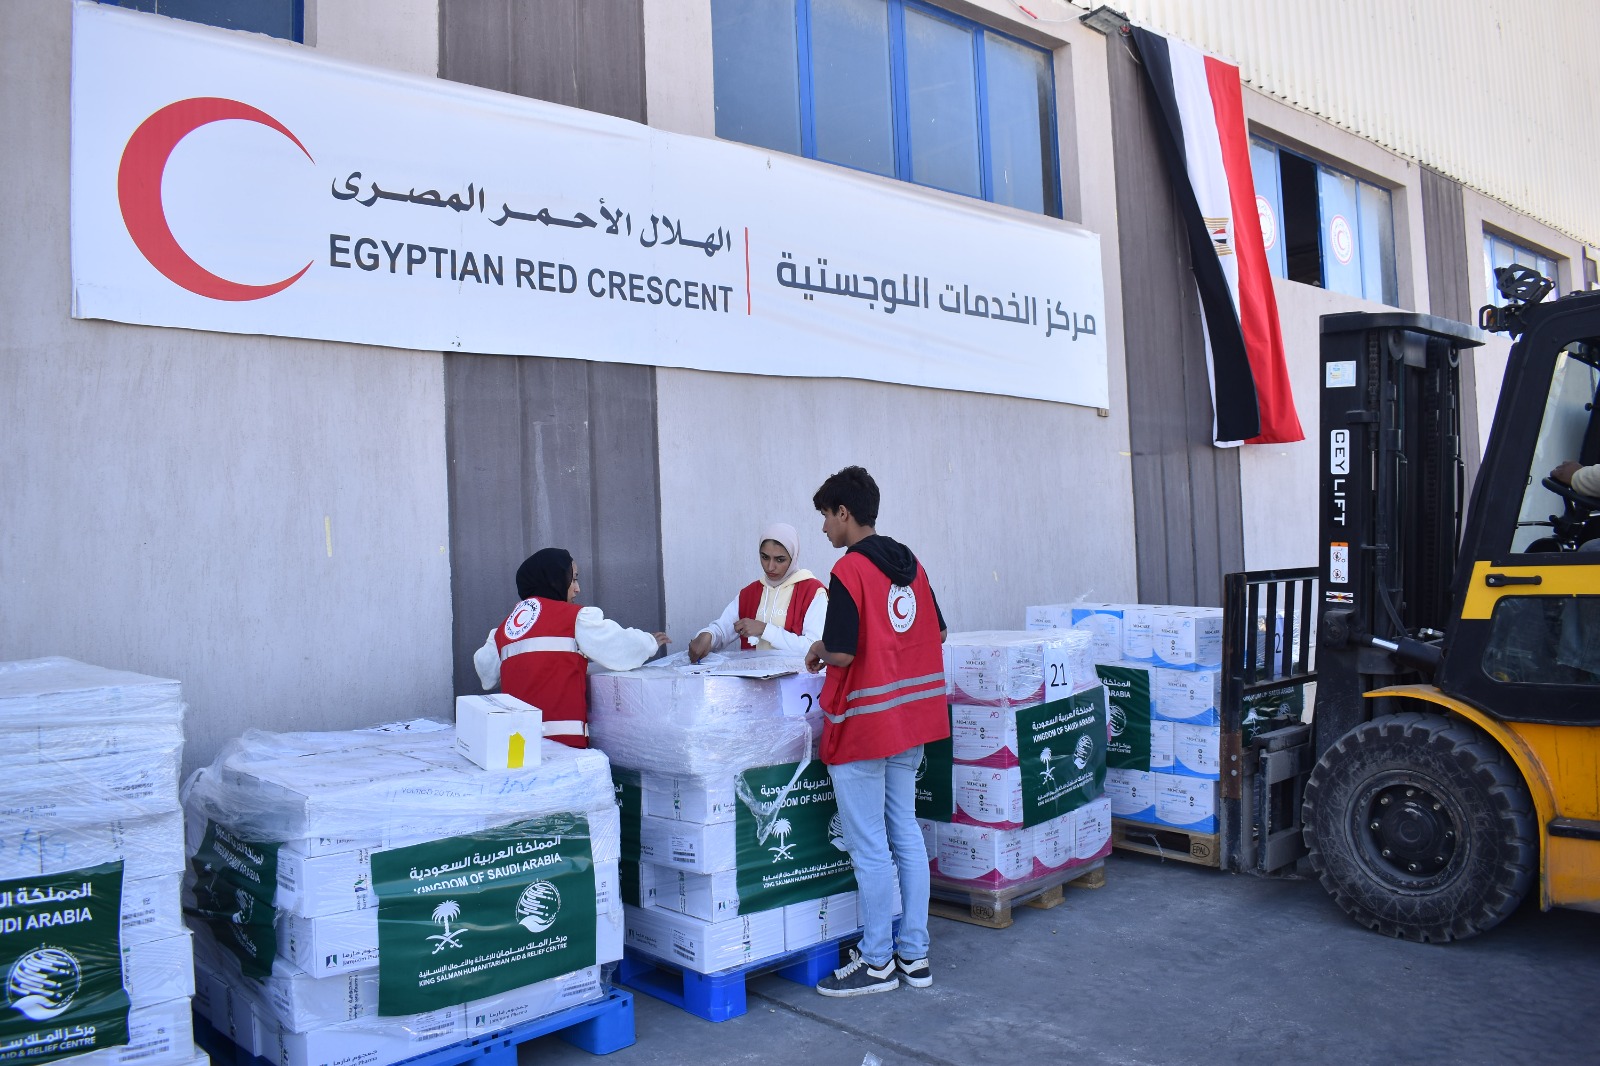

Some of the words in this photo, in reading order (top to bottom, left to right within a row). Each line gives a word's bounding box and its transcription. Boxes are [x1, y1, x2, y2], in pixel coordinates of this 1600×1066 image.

[488, 197, 631, 236] الأحمر
[639, 213, 731, 257] الهلال
[329, 233, 504, 286] EGYPTIAN
[515, 257, 578, 294] RED
[587, 268, 734, 313] CRESCENT
[776, 251, 929, 314] اللوجستية
[938, 283, 1037, 326] الخدمات
[1045, 298, 1097, 342] مركز
[1335, 431, 1346, 472] CEY
[1333, 479, 1346, 526] LIFT
[1050, 662, 1067, 687] 21
[1102, 677, 1131, 688] المملكة
[1032, 729, 1057, 743] KINGDOM
[1056, 726, 1064, 734] OF
[1064, 720, 1079, 733] SAUDI
[1079, 715, 1096, 727] ARABIA
[803, 776, 831, 790] العربية
[800, 795, 811, 805] OF
[472, 845, 514, 866] العربية
[515, 835, 561, 854] المملكة
[409, 856, 471, 881] السعودية
[469, 872, 485, 884] OF
[487, 863, 521, 880] SAUDI
[522, 852, 562, 872] ARABIA
[16, 882, 93, 904] المملكة
[25, 906, 93, 931] ARABIA
[496, 945, 525, 960] سلمان
[525, 937, 548, 951] الملك
[547, 935, 568, 947] مركز
[418, 975, 436, 988] KING
[436, 969, 463, 984] SALMAN
[463, 957, 511, 976] HUMANITARIAN
[510, 954, 522, 963] AID
[527, 948, 545, 959] RELIEF
[545, 942, 568, 954] CENTRE
[25, 1028, 64, 1046] الملك
[64, 1025, 96, 1041] مركز
[19, 1049, 27, 1057] &
[27, 1043, 58, 1057] RELIEF
[59, 1036, 97, 1050] CENTRE
